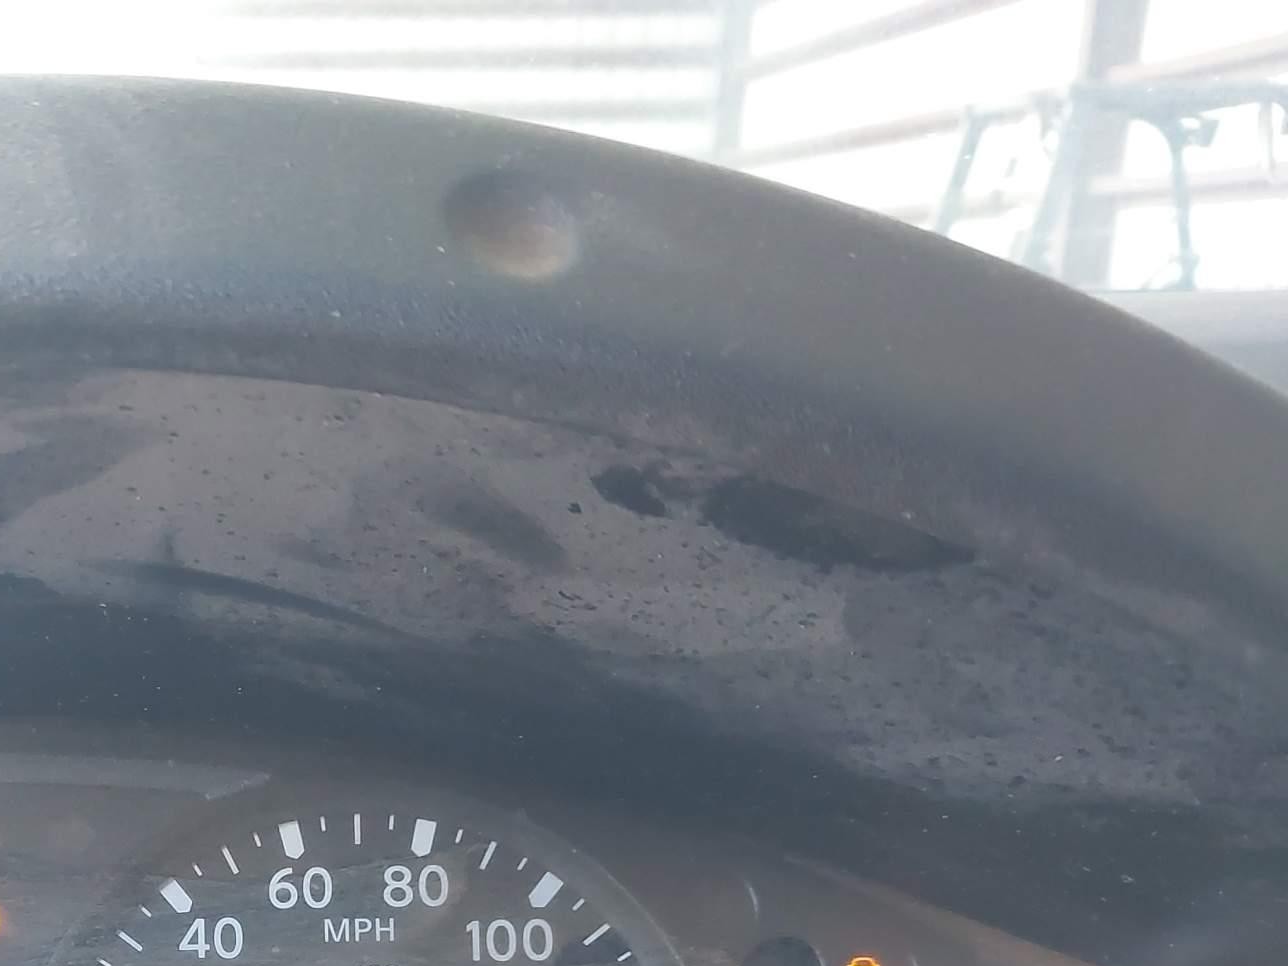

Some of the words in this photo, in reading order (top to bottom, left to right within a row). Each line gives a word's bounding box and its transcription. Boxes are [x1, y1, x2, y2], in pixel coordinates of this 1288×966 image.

[269, 867, 333, 908] 60
[383, 865, 449, 907] 80
[179, 918, 244, 958] 40
[324, 918, 396, 943] MPH
[466, 919, 554, 961] 100
